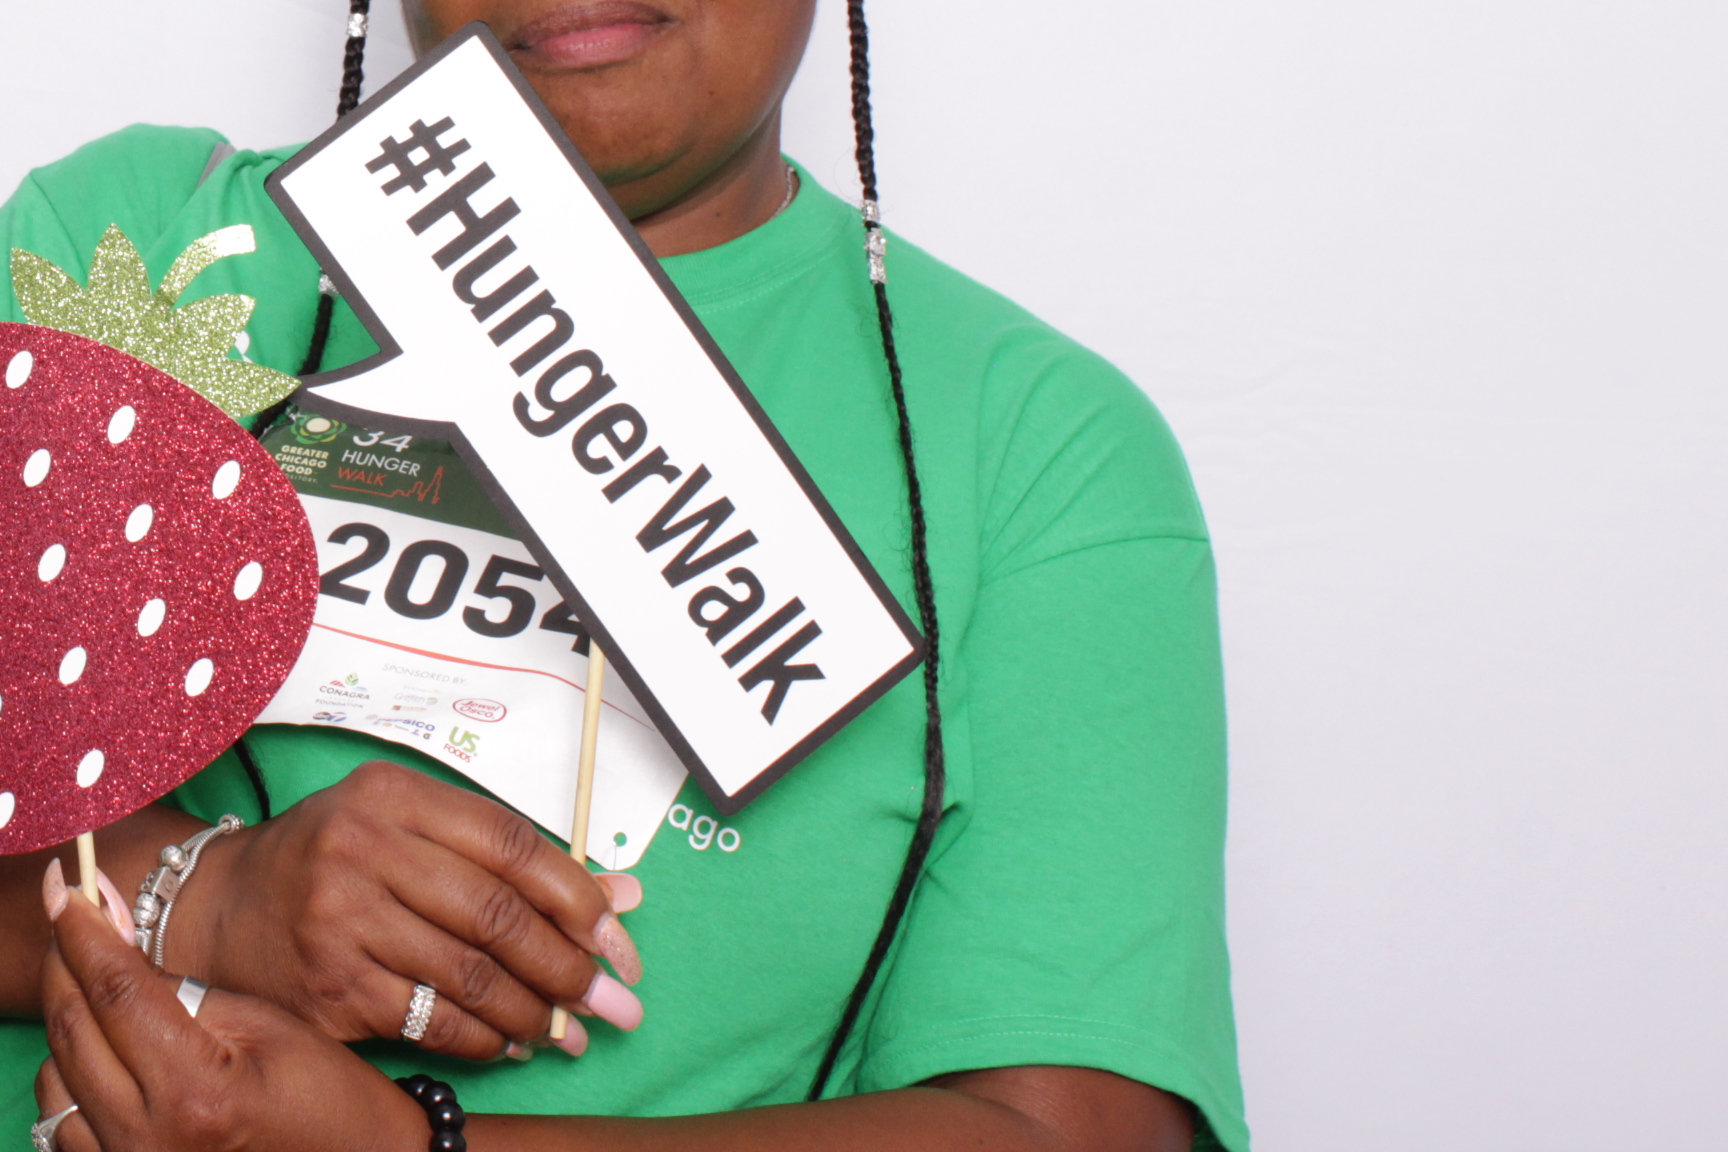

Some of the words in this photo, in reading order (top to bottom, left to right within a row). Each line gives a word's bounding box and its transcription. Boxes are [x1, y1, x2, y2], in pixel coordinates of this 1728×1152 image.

[364, 115, 826, 726] #HungerWalk
[274, 452, 327, 469] CHICAGO
[280, 444, 330, 460] GREATER
[279, 463, 313, 476] FOOD
[341, 449, 421, 477] HUNGER
[337, 466, 389, 487] WALK
[382, 663, 450, 684] SPONSORED
[319, 685, 370, 701] CONAGRA
[443, 743, 472, 764] FOODS
[667, 803, 741, 853] ago
